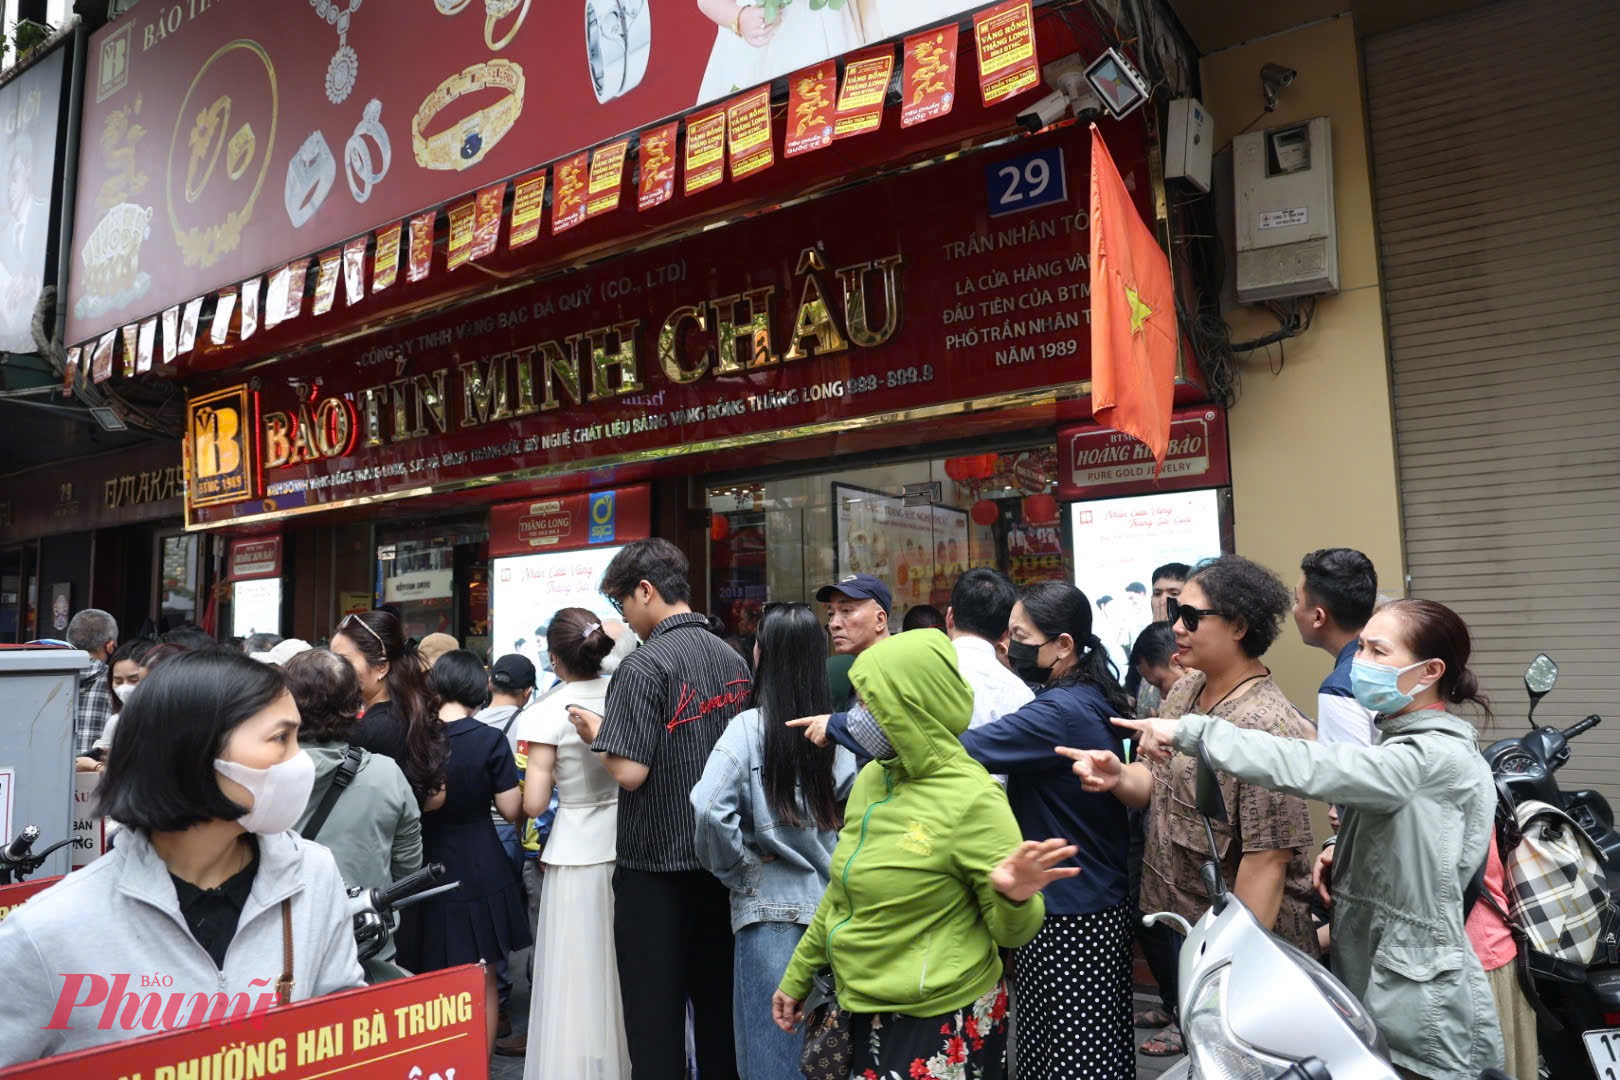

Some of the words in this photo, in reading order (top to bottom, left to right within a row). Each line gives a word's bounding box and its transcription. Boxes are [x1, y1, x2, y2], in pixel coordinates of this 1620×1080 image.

[143, 6, 182, 51] BẢO
[1008, 28, 1029, 41] LONG
[997, 158, 1050, 204] 29
[943, 231, 994, 262] TRẦN
[999, 216, 1055, 249] NHÂN
[1061, 208, 1091, 235] TÔ
[955, 276, 975, 296] LÀ
[978, 267, 1009, 290] CỬA
[1013, 258, 1062, 284] HÀNG
[1066, 252, 1091, 273] VÀ
[943, 301, 975, 324] ĐẦU
[979, 296, 1015, 316] TIÊN
[1018, 287, 1053, 310] CỦA
[1057, 281, 1091, 302] BTM
[980, 318, 1027, 344] TRẦN
[1028, 310, 1079, 334] NHÂN
[263, 383, 350, 469] BẢO
[357, 356, 449, 449] TÍN
[459, 319, 645, 428] MINH
[657, 246, 903, 385] CHÂU
[995, 345, 1035, 366] NĂM
[1039, 339, 1078, 358] 1989
[541, 428, 571, 449] NGHỆ
[573, 422, 603, 443] CHẤT
[605, 419, 631, 438] LIỆU
[633, 410, 668, 433] BẰNG
[747, 388, 800, 412] THĂNG
[802, 380, 844, 403] LONG
[1077, 443, 1130, 466] HOÀNG
[1167, 432, 1202, 456] BẢO
[104, 464, 185, 508] OMAKAS
[1087, 468, 1113, 481] PURE
[1115, 465, 1144, 477] GOLD
[519, 519, 546, 532] THĂNG
[547, 517, 569, 528] LONG
[73, 820, 93, 831] BÁN
[297, 1022, 343, 1066] HAI
[352, 1009, 388, 1051] BÀ
[393, 991, 473, 1040] TRƯNG
